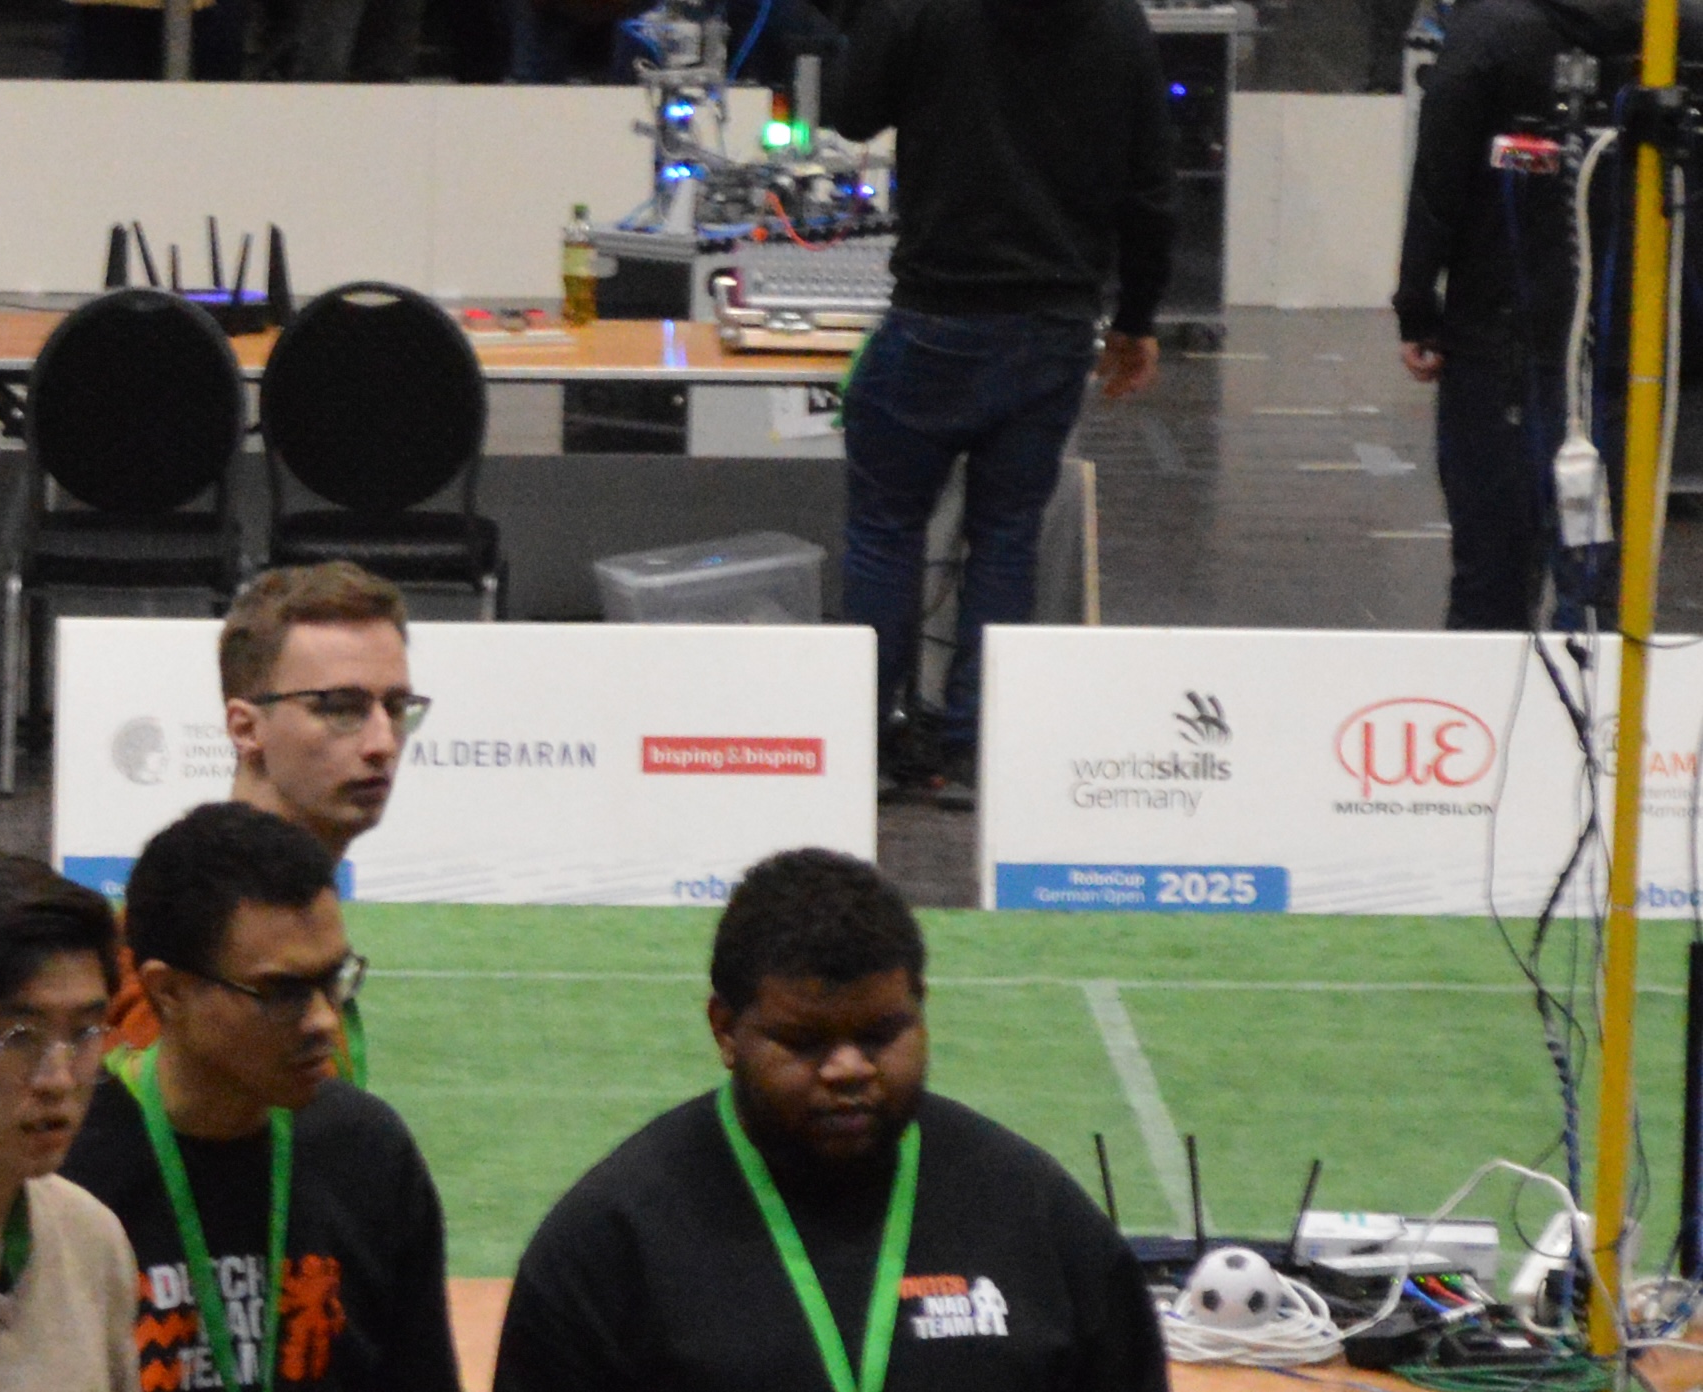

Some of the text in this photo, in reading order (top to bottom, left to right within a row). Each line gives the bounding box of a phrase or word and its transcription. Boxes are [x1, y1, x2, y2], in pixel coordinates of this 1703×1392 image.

[409, 740, 596, 769] ALDEBARAN
[650, 744, 720, 770] bisping
[745, 745, 818, 771] bisping
[1071, 750, 1231, 782] worldskills
[1071, 781, 1203, 816] Germany
[1333, 801, 1495, 817] MICRO-EPSILON
[1069, 870, 1145, 889] RoboCup
[1156, 871, 1257, 904] 2025
[923, 1294, 972, 1317] NAO
[912, 1315, 975, 1340] TEAM
